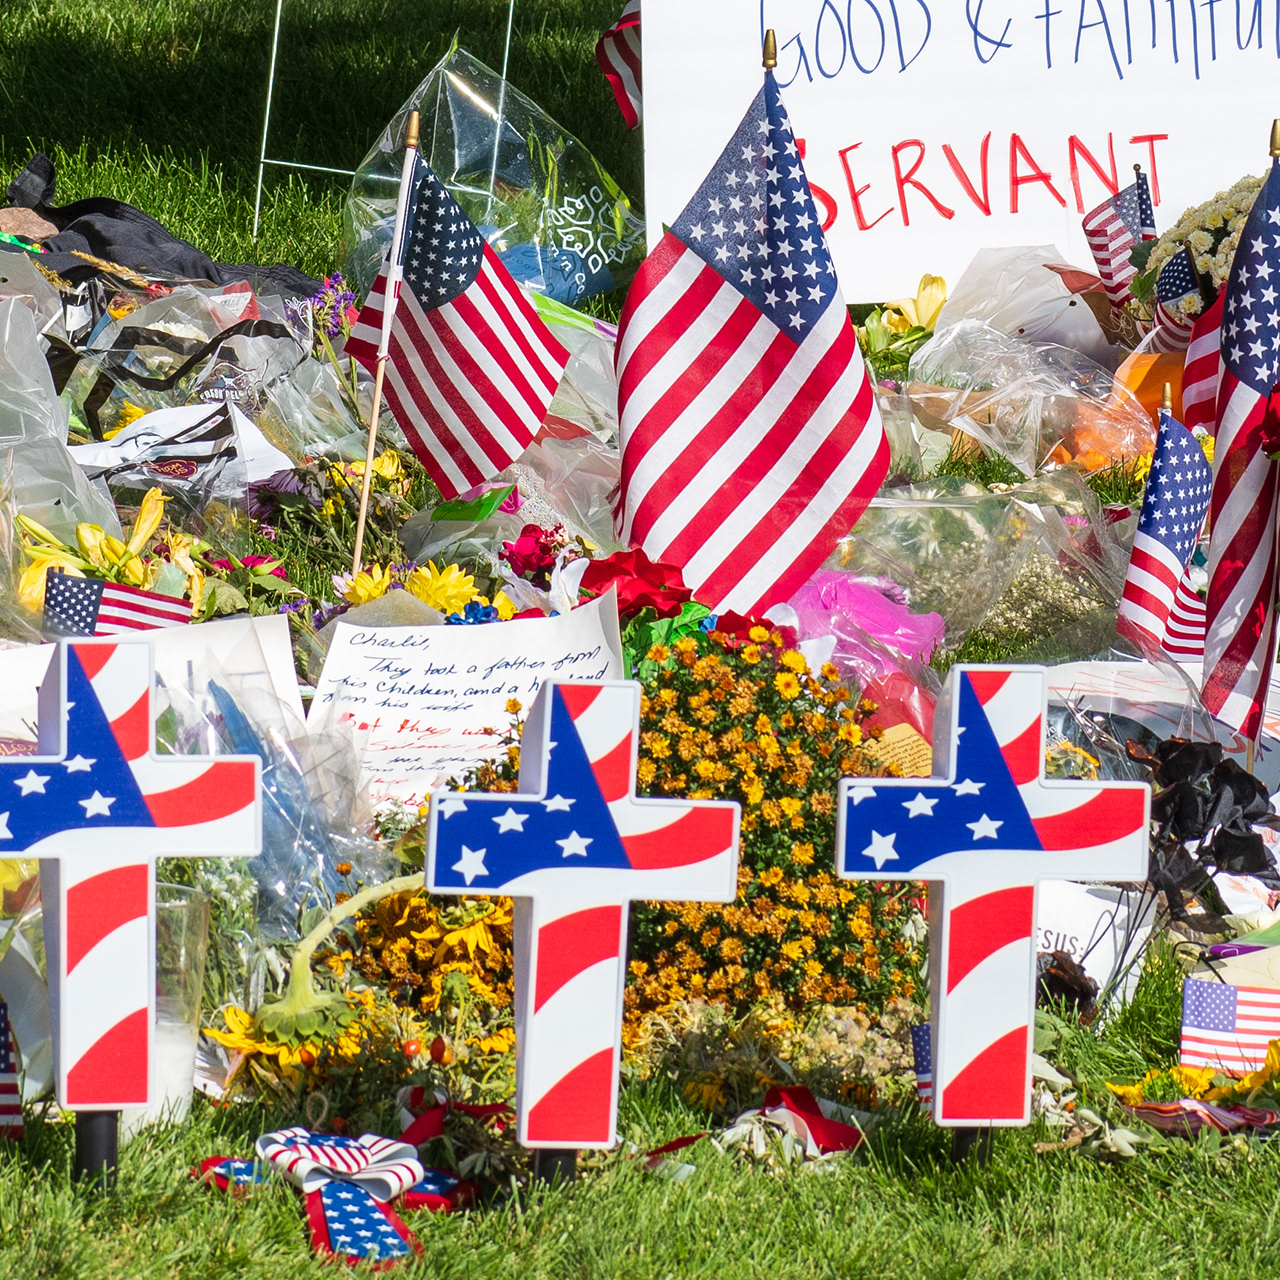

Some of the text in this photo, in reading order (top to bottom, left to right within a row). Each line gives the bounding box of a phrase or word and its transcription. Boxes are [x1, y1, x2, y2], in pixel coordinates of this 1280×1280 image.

[364, 656, 412, 680] They
[424, 662, 458, 676] took
[466, 664, 478, 674] a
[484, 656, 546, 680] father
[551, 645, 602, 671] from
[328, 675, 367, 688] his
[463, 681, 506, 696] and
[507, 685, 519, 694] a
[375, 697, 409, 709] his
[420, 700, 474, 713] wife
[396, 719, 452, 741] they
[1037, 927, 1084, 958] SUS:
